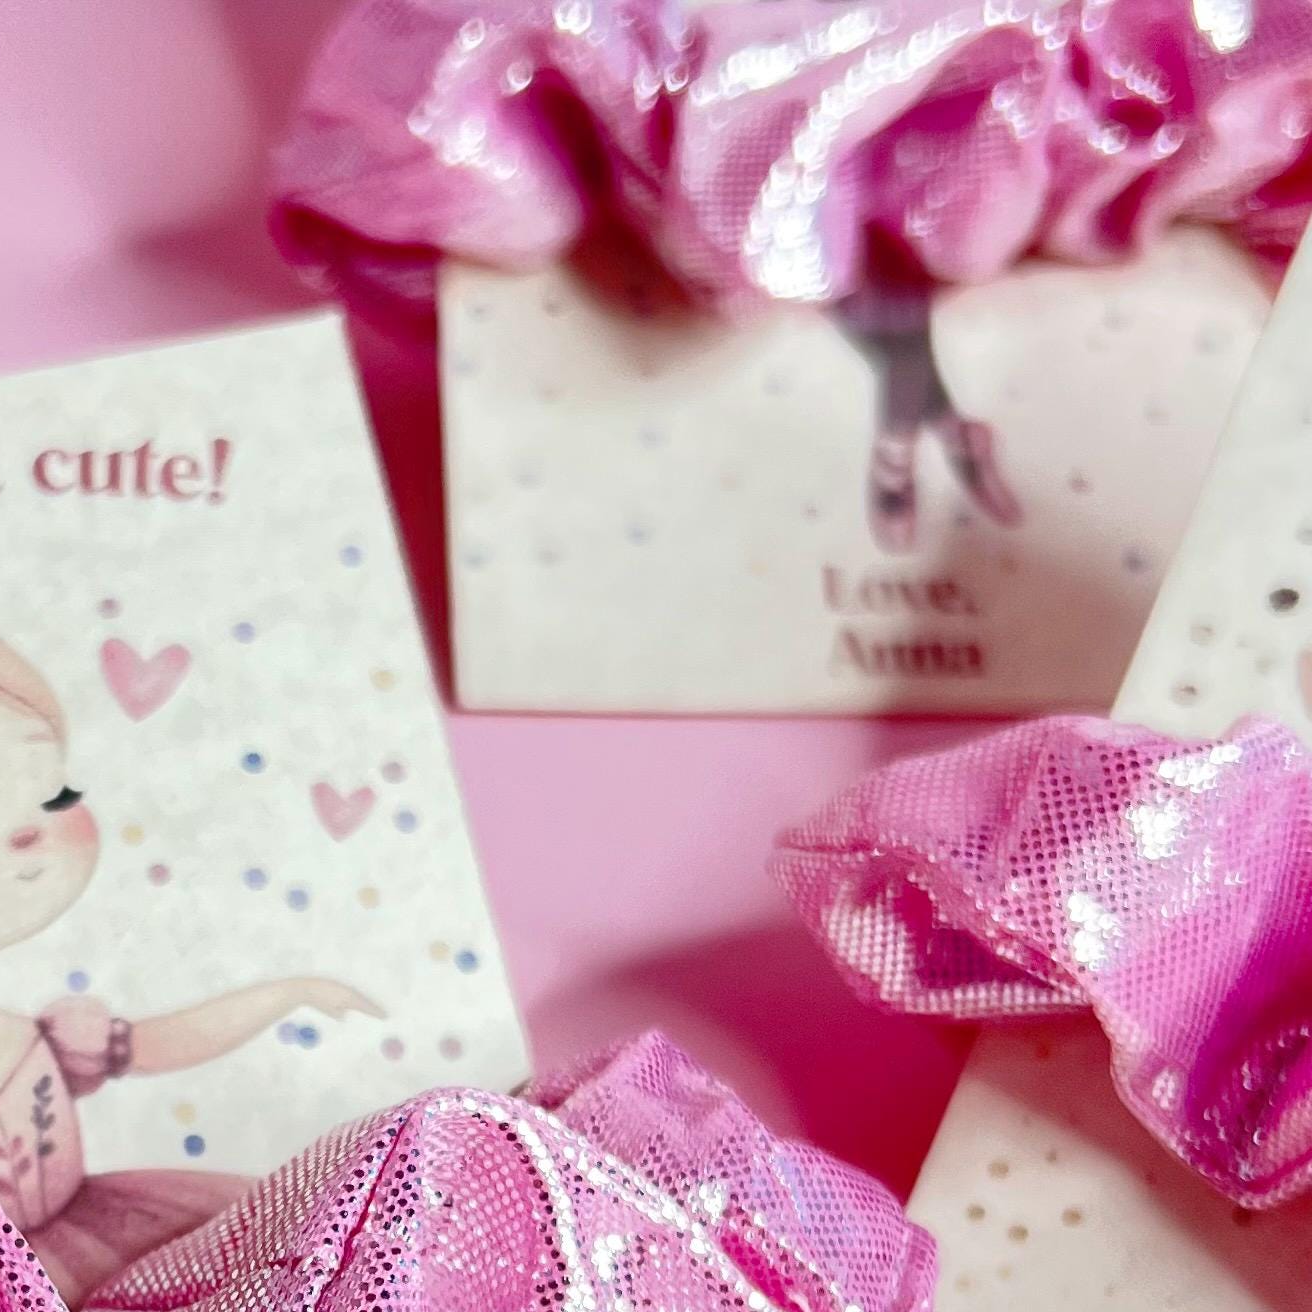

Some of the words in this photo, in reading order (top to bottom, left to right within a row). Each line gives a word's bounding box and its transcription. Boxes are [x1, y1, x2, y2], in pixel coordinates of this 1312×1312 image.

[31, 437, 232, 504] cute!
[820, 563, 980, 616] Love,
[828, 628, 985, 679] Anna
